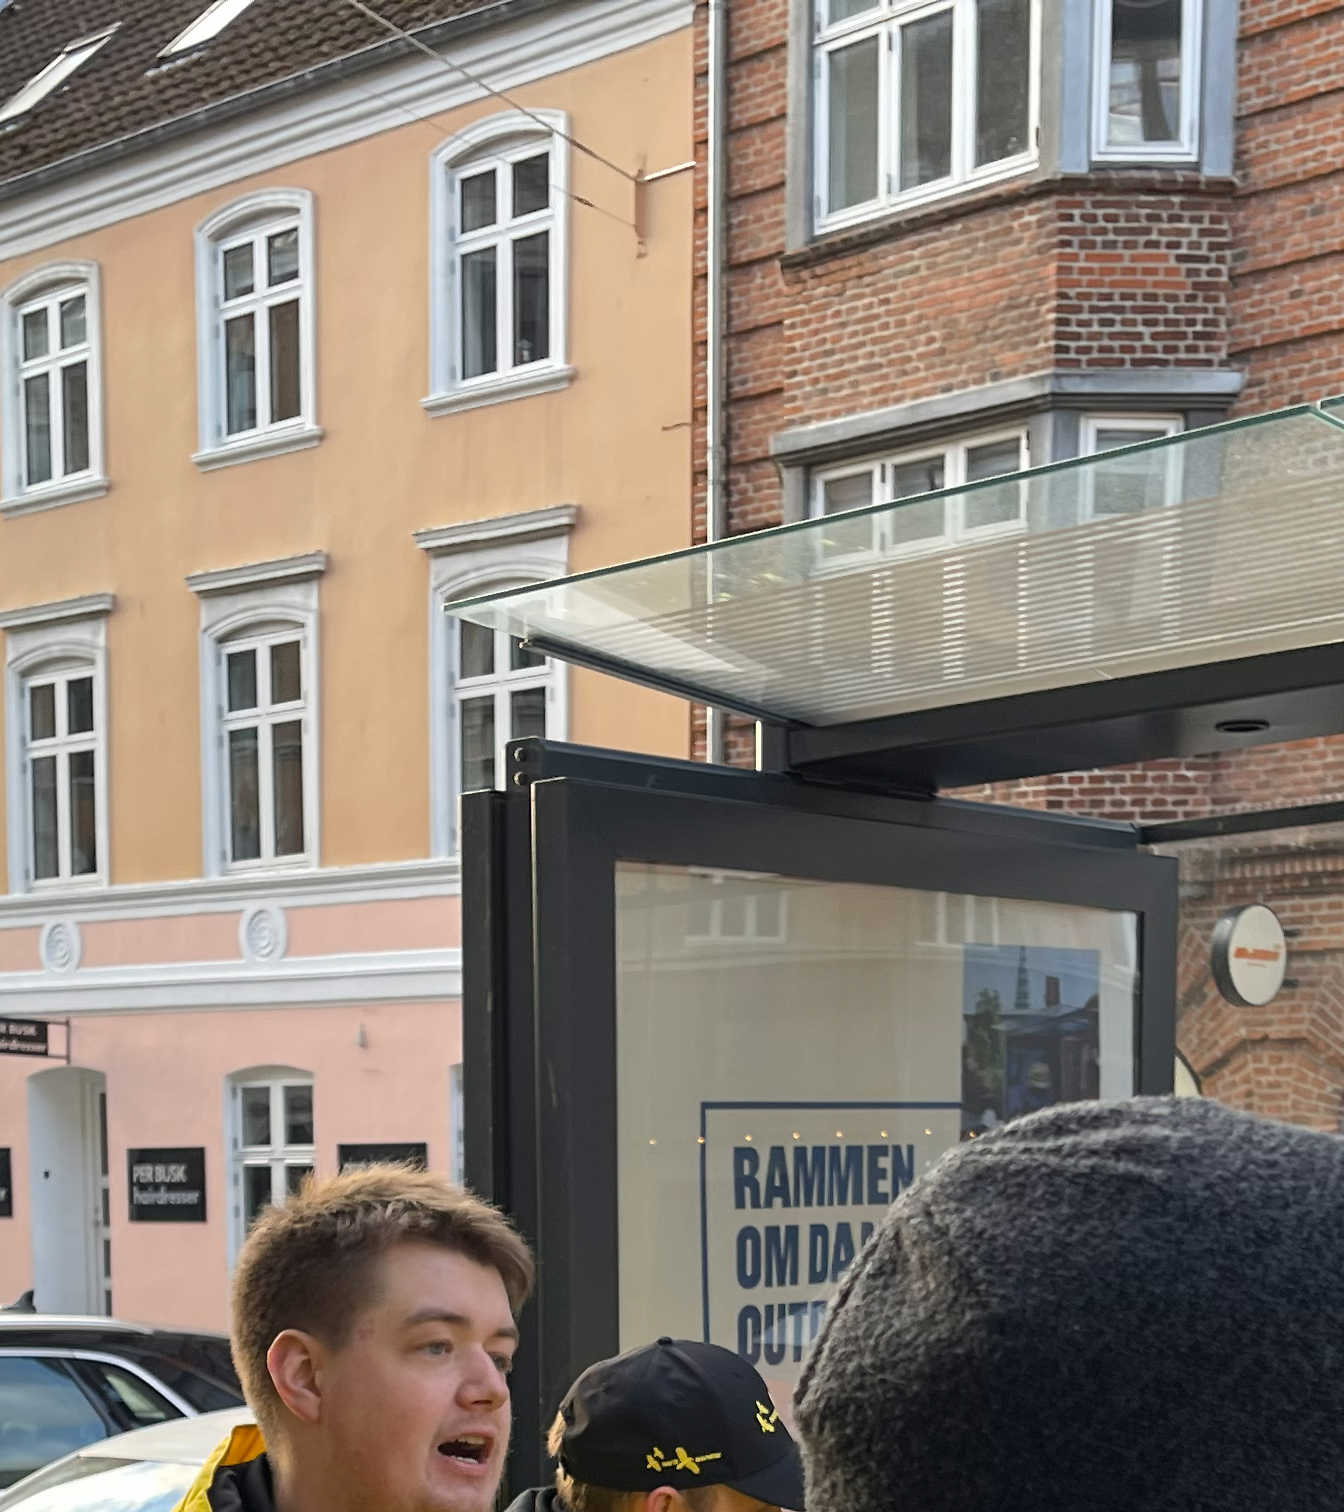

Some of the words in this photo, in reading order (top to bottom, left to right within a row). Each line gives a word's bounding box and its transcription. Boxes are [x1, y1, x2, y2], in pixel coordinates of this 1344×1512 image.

[132, 1163, 154, 1183] PER
[155, 1163, 187, 1183] BUSK
[733, 1144, 914, 1210] RAMMEN
[132, 1185, 200, 1205] hairdresser
[736, 1224, 800, 1289] OM
